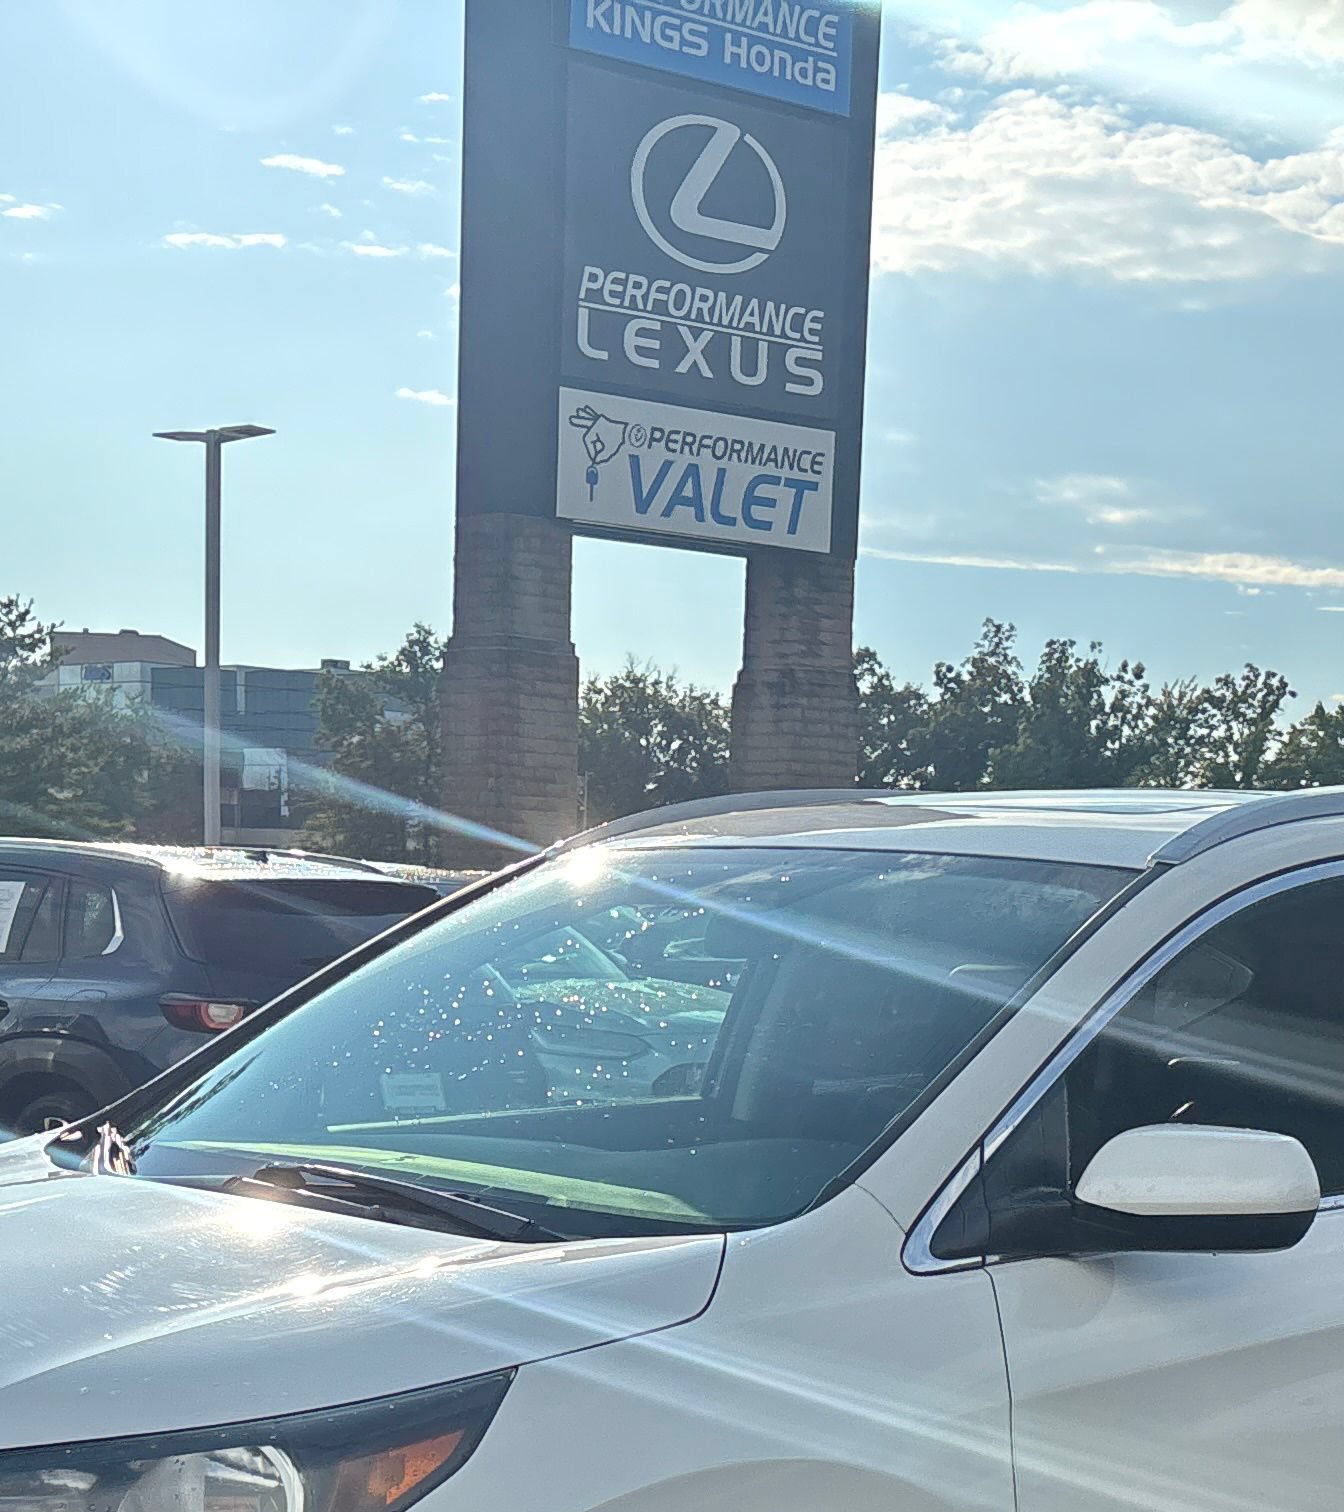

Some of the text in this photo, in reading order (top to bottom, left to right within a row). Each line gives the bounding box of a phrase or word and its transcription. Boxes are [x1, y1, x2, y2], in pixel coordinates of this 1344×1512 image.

[586, 0, 837, 92] KINGS Honda
[578, 265, 825, 343] PERFORMANCE
[577, 306, 824, 396] LEXUS
[647, 426, 826, 476] PERFORMANCE
[628, 453, 820, 536] VALET
